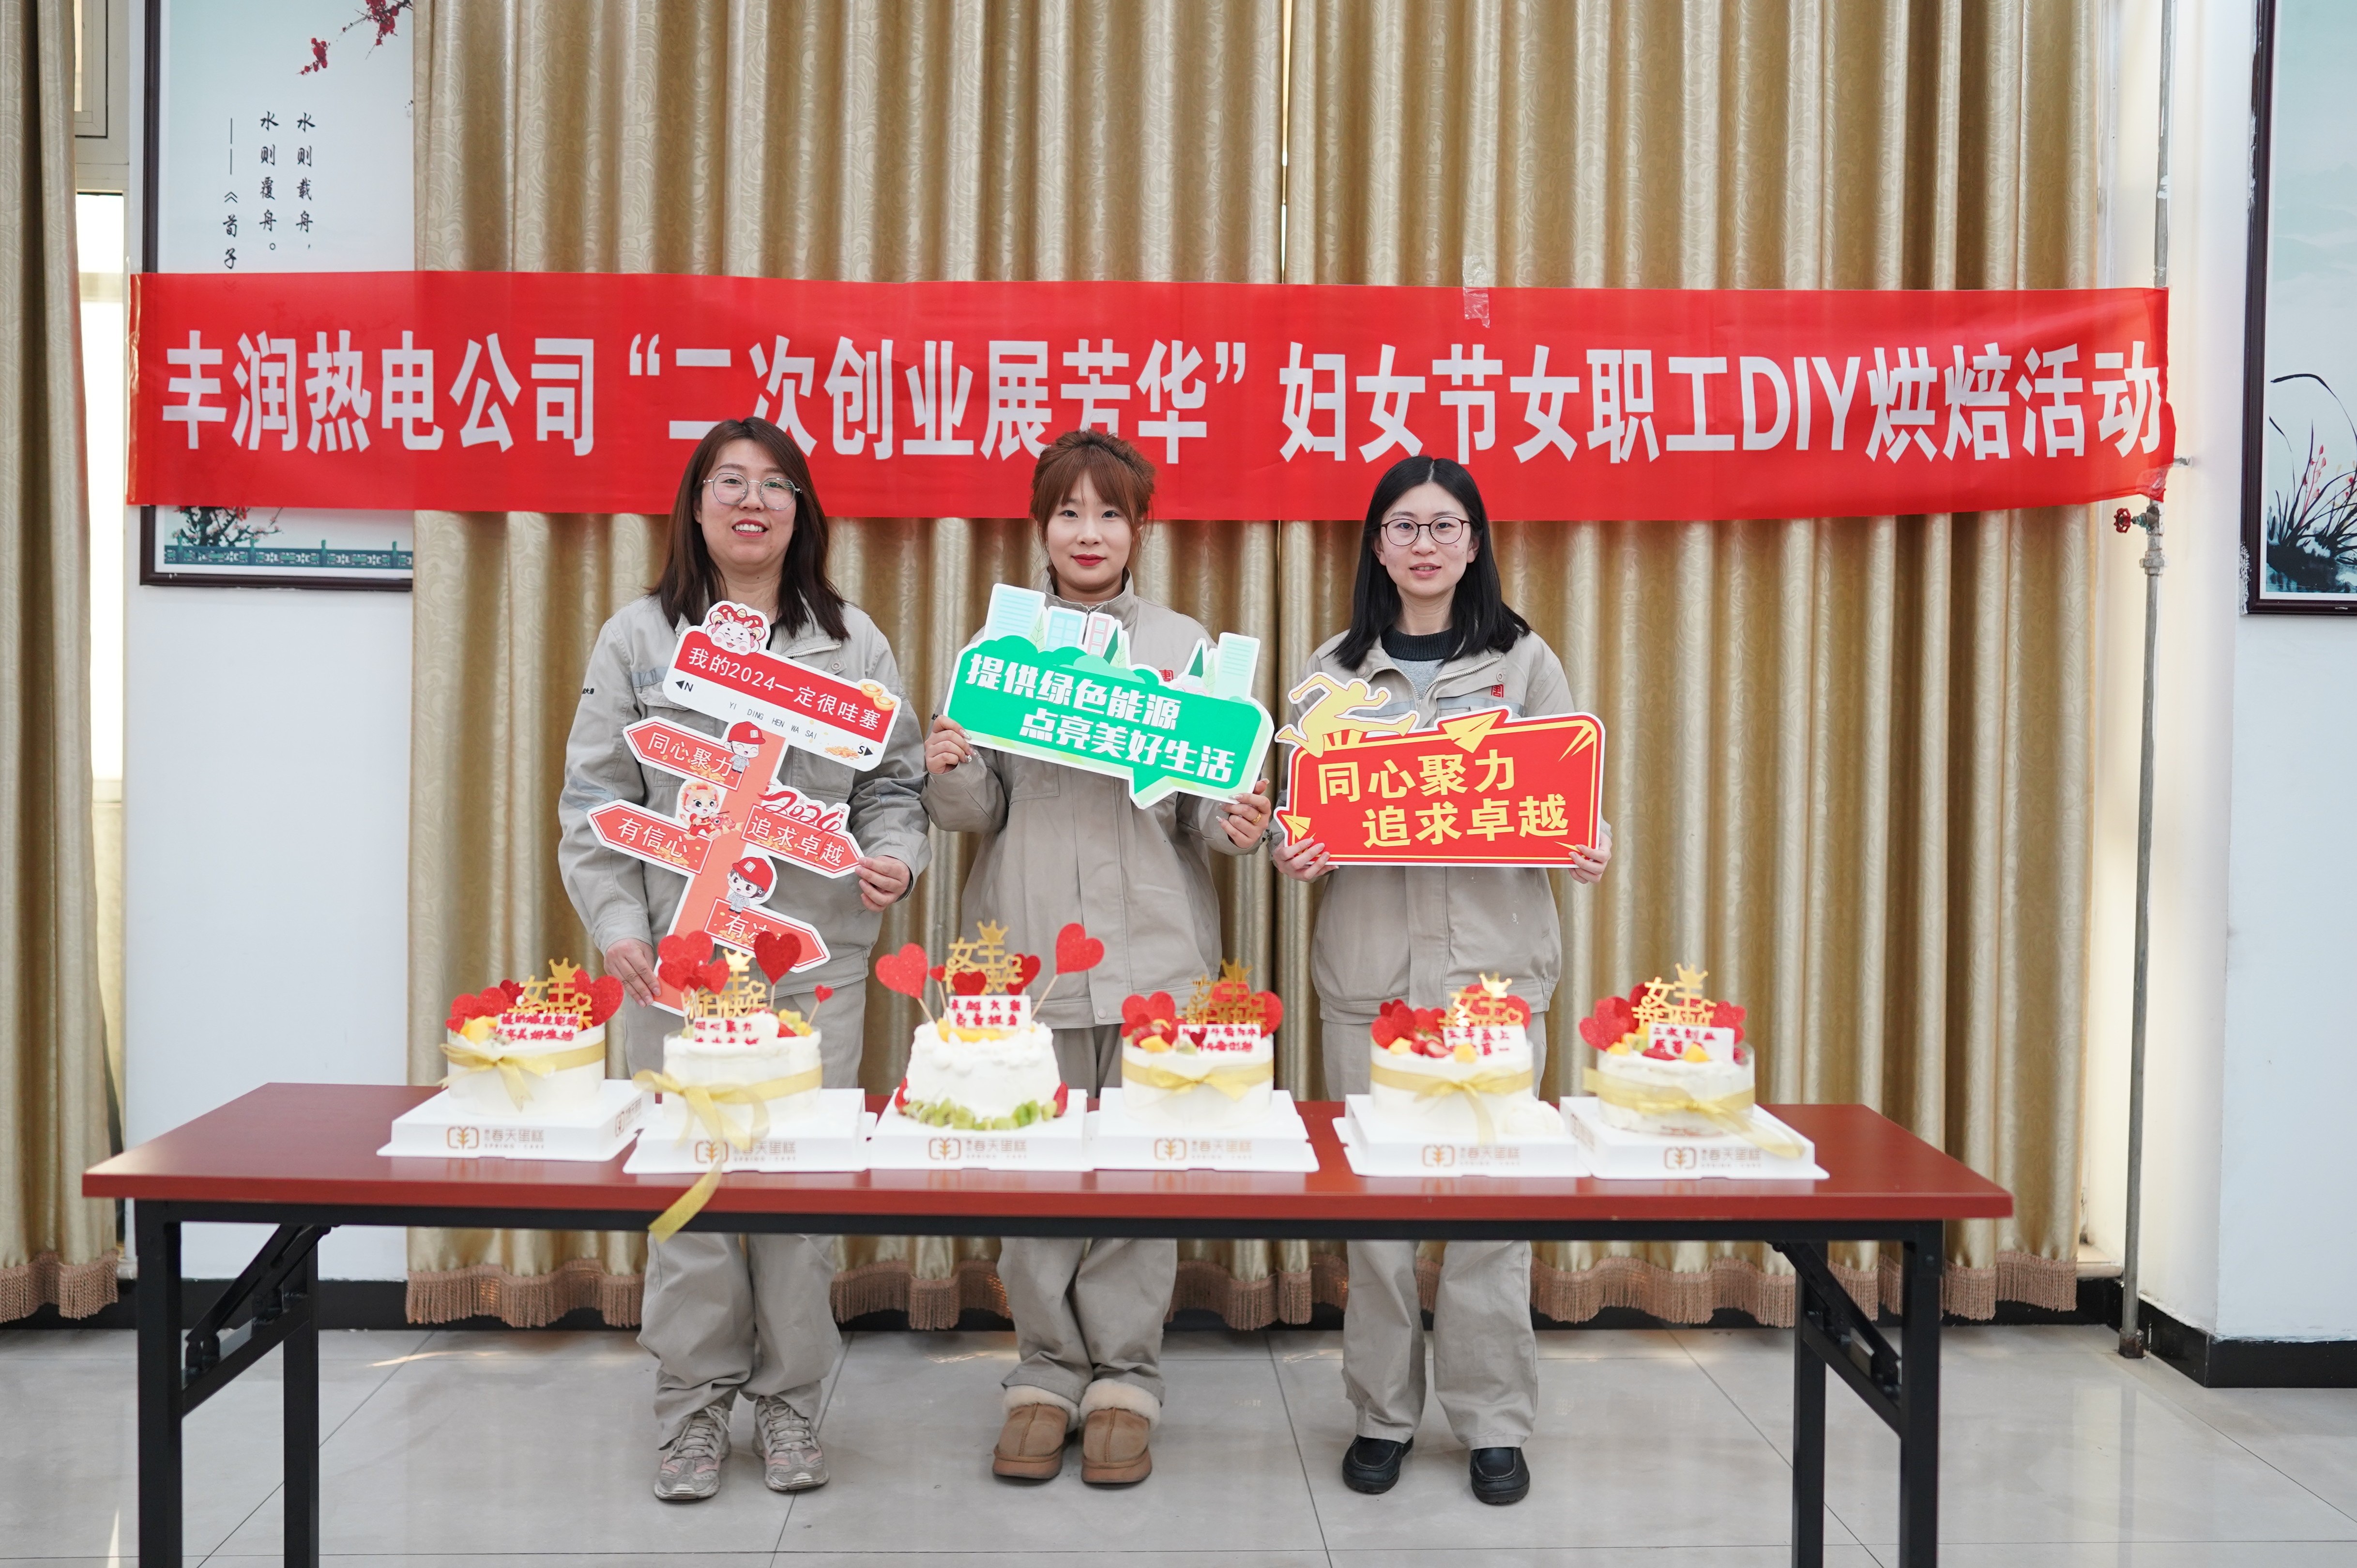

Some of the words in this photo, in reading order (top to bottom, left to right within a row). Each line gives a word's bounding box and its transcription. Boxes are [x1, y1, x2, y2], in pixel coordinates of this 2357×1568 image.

[684, 682, 693, 692] N
[689, 647, 881, 731] 我的2024一定很哇塞
[966, 654, 1181, 730] 提供绿色能源
[730, 701, 736, 710] YI
[747, 708, 764, 720] DING
[772, 718, 785, 727] HEN
[791, 724, 799, 733] WA
[806, 730, 817, 740] SAI
[1019, 708, 1235, 783] 点亮美好生活
[647, 731, 733, 777] 同心聚力
[857, 746, 865, 755] S
[1318, 749, 1515, 805] 同心聚力
[617, 817, 687, 859] 有信心
[747, 815, 844, 867] 追求卓越
[1362, 793, 1570, 848] 追求卓越
